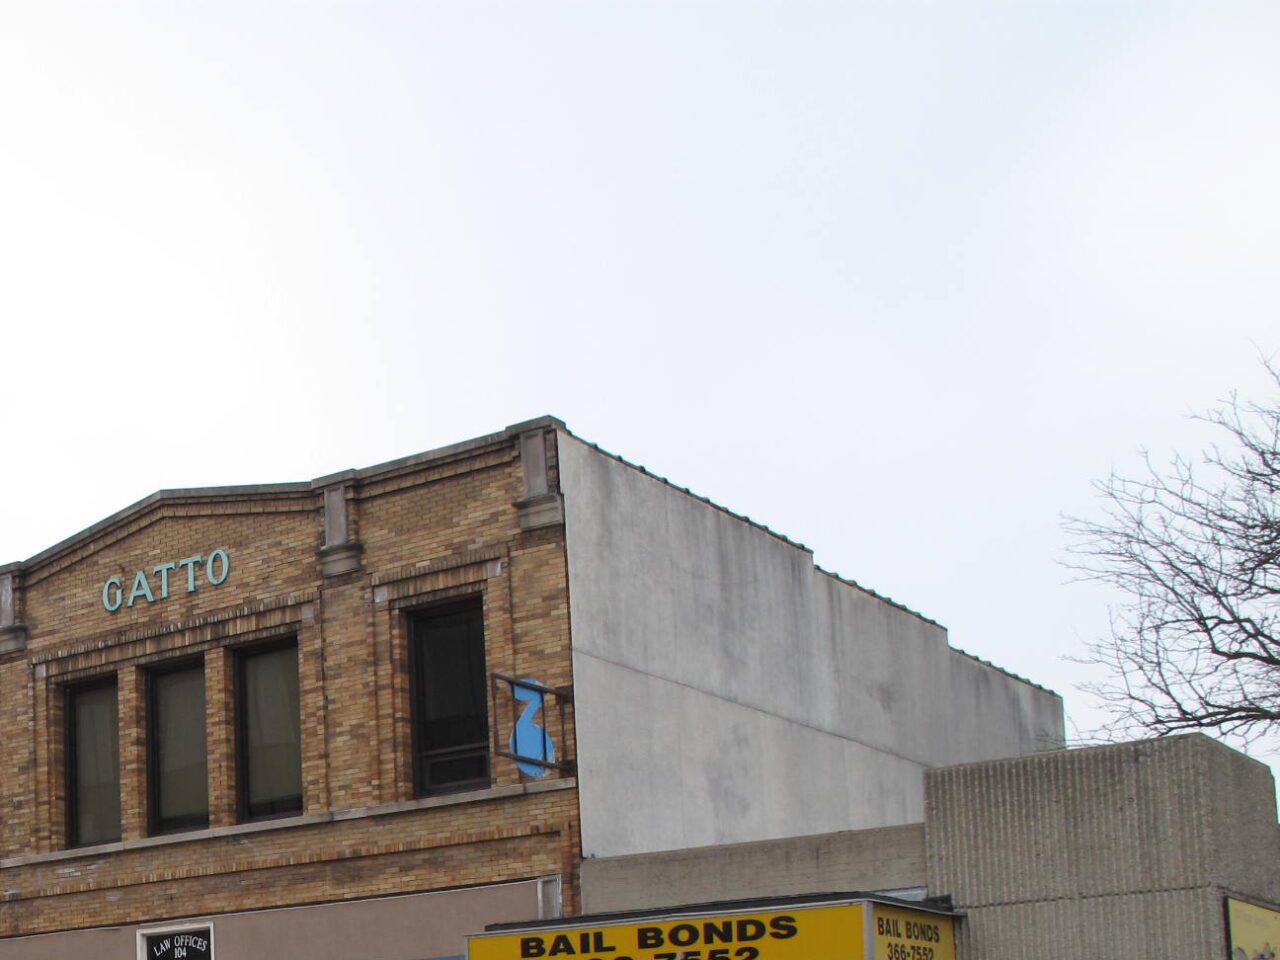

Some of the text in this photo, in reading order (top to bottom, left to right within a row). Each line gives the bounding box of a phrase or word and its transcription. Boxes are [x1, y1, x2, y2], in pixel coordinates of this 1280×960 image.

[102, 549, 230, 612] GATTO
[520, 916, 798, 958] BAIL BONDS
[877, 917, 940, 944] BAIL BONDS
[153, 934, 208, 957] LAW OFFICES
[174, 947, 187, 959] 104
